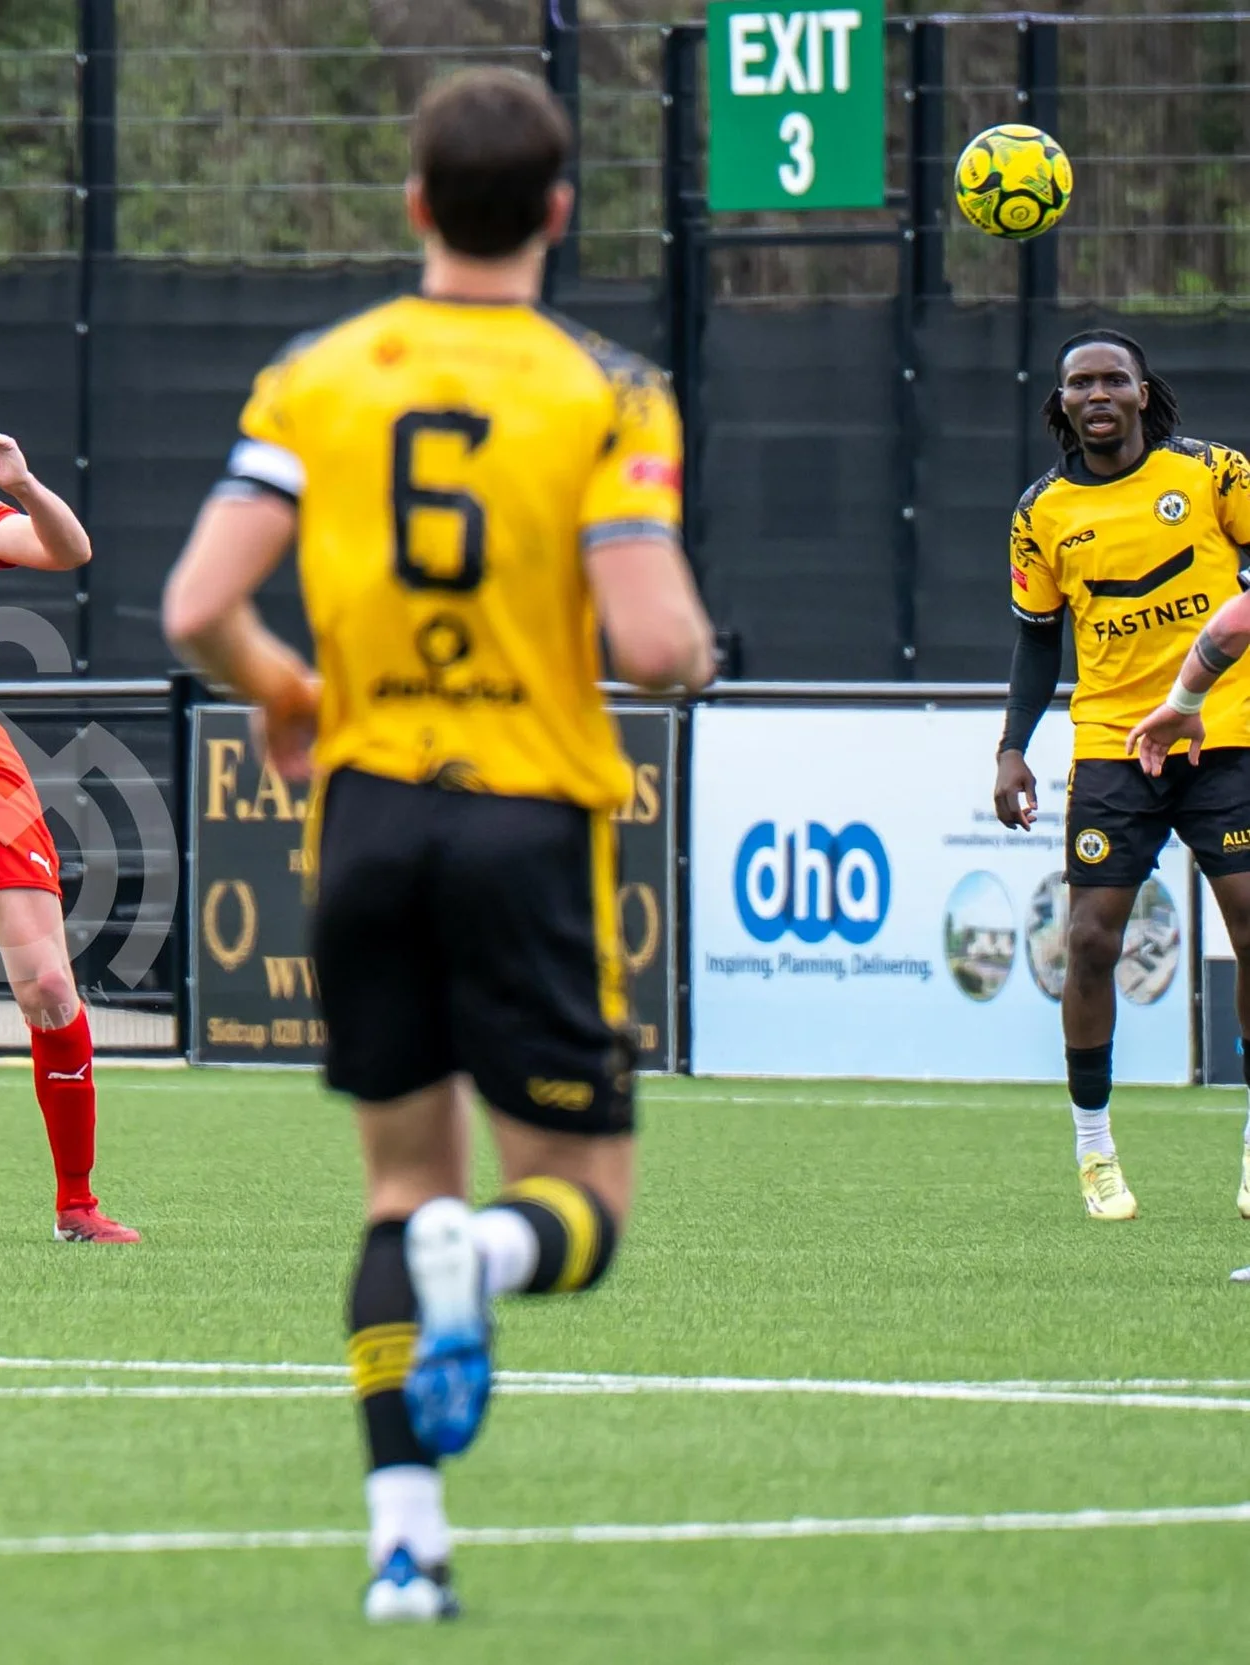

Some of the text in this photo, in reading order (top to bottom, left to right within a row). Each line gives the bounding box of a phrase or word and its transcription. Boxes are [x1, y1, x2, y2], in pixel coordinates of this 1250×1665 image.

[729, 9, 862, 95] EXIT
[778, 111, 815, 196] 3
[392, 410, 490, 590] 6
[1093, 592, 1210, 642] FASTNED
[745, 820, 880, 923] dha
